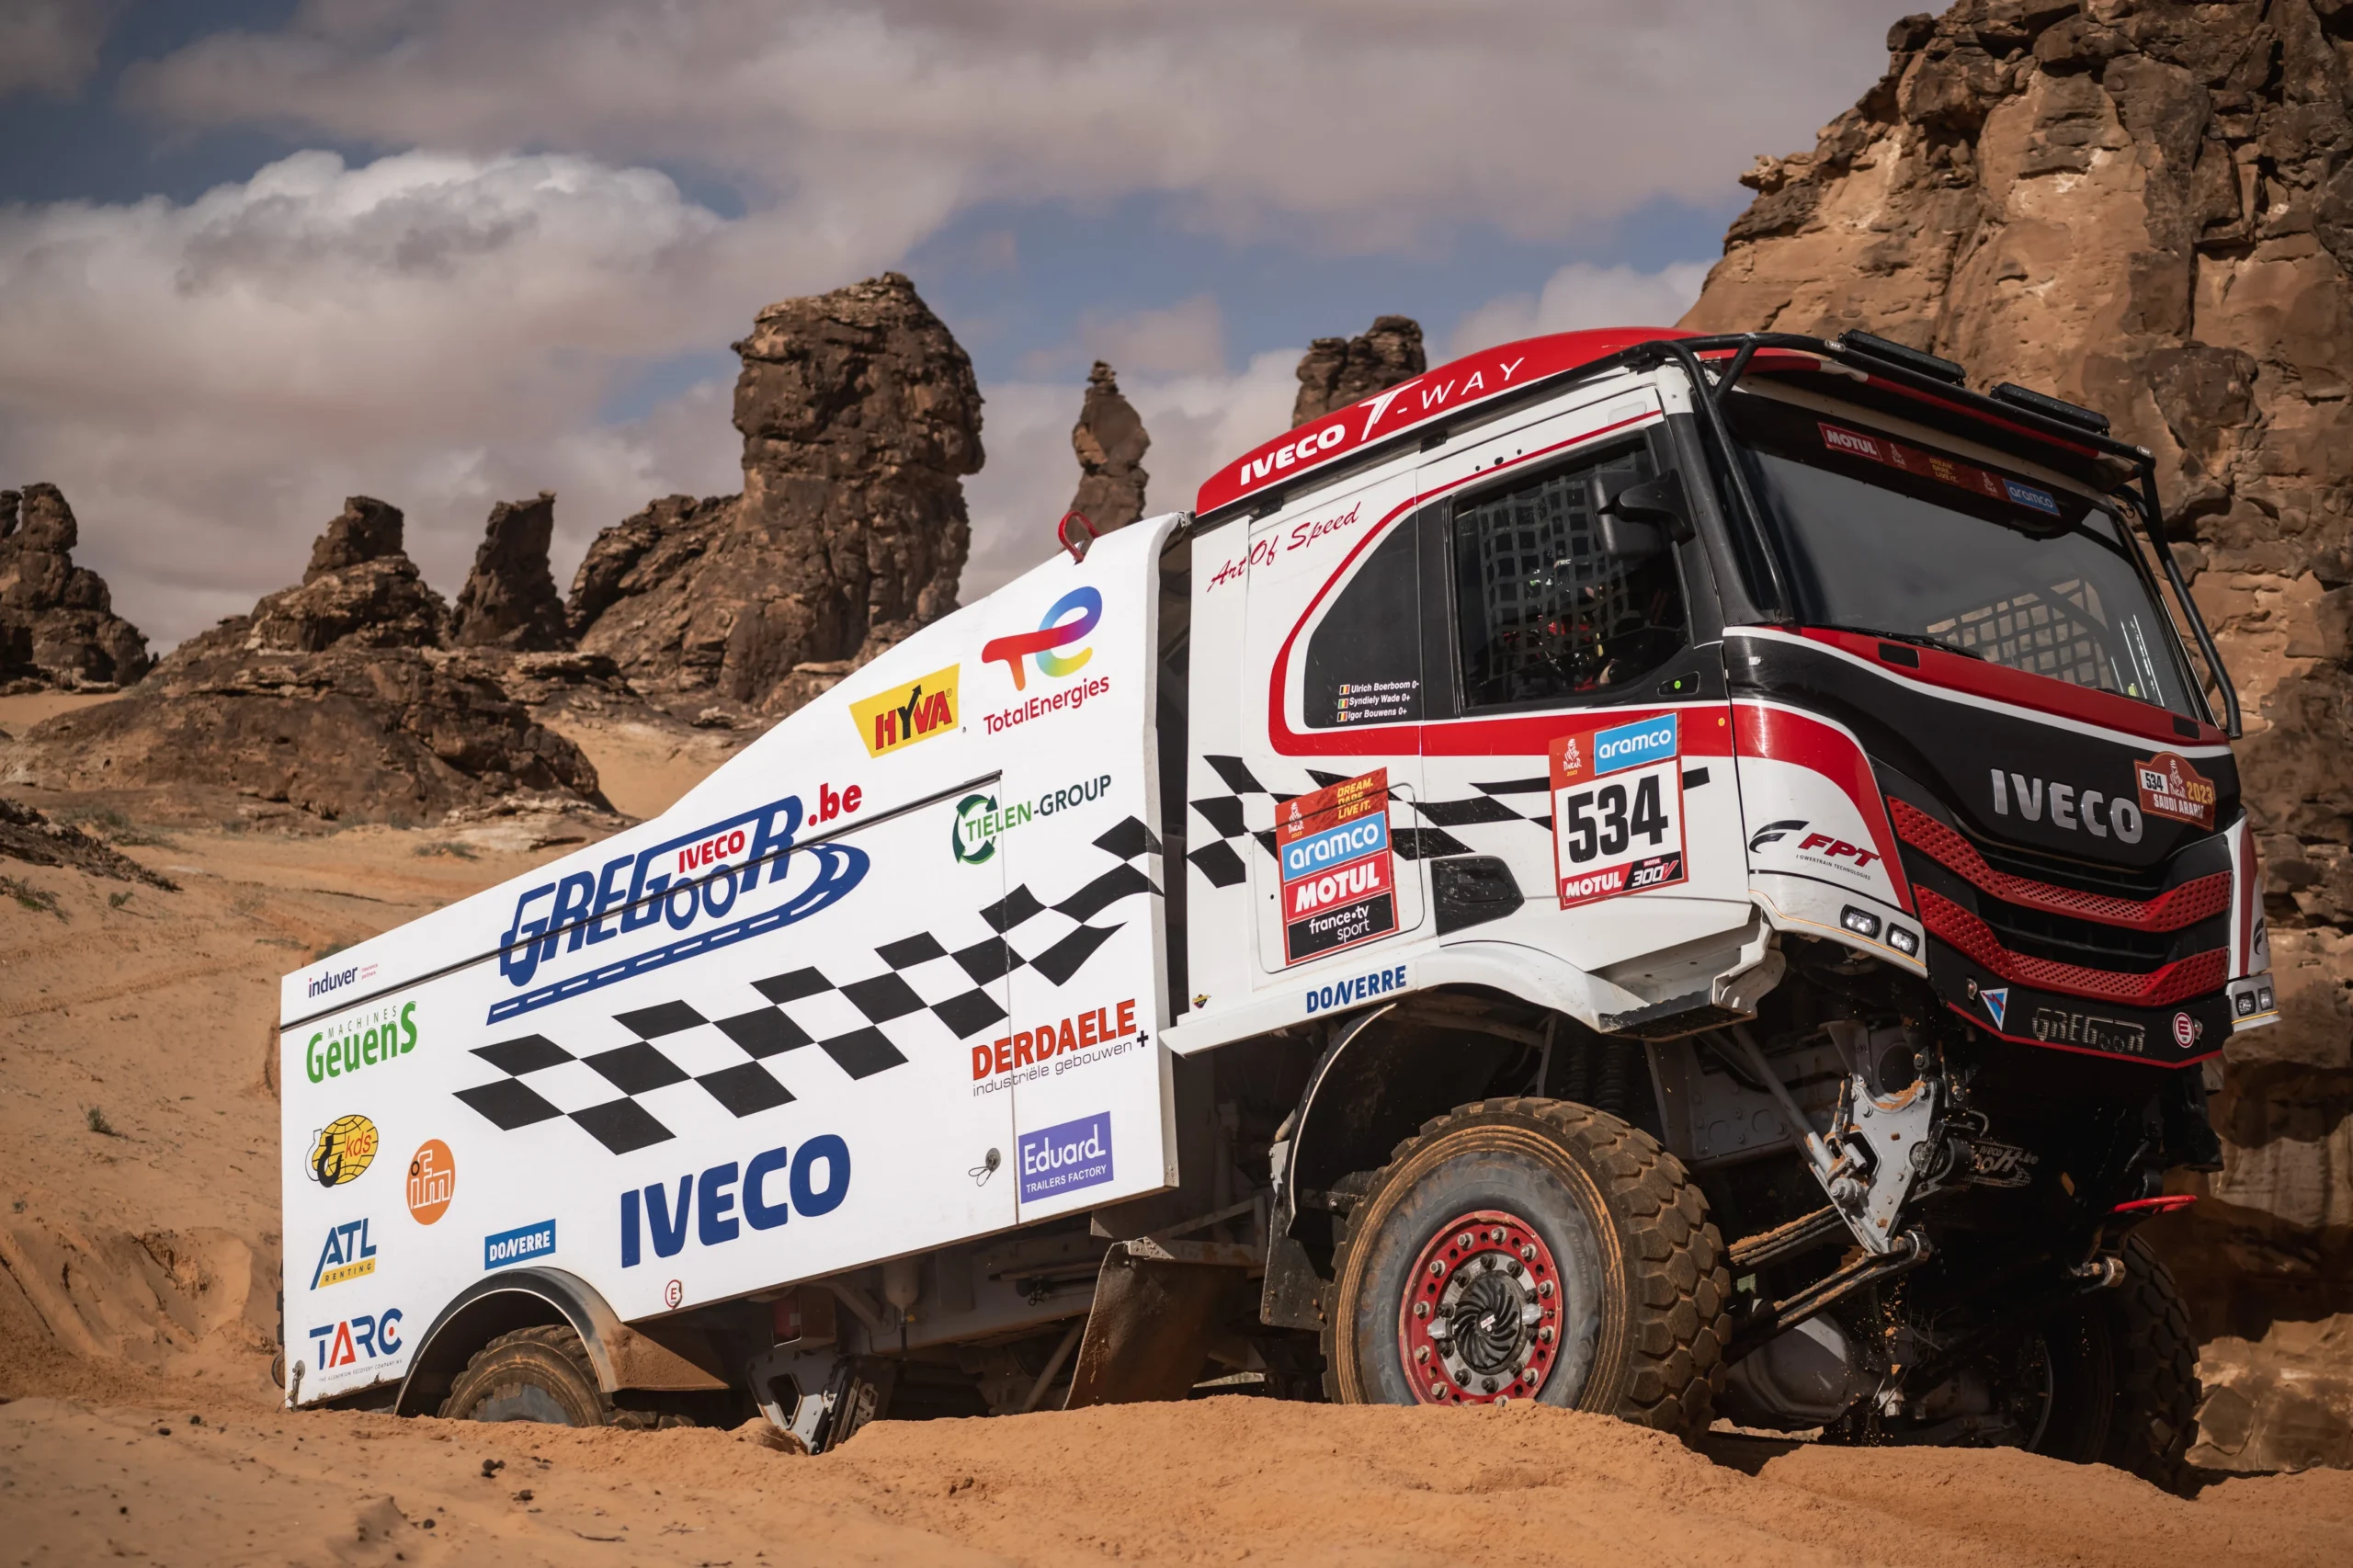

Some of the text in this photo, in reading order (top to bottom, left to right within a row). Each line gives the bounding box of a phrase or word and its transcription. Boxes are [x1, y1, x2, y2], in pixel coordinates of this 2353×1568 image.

[1240, 424, 1346, 486] IVECO
[1825, 429, 1878, 456] MOTUL
[2008, 486, 2053, 509] aramco
[1206, 501, 1361, 593] Art Of Speed
[1349, 696, 1380, 707] Syndiely
[1381, 694, 1400, 703] Wade
[1351, 684, 1372, 693] Ulrich
[1373, 681, 1410, 691] Boerboom
[875, 684, 953, 750] HYVA
[983, 676, 1109, 735] TotalEnergies
[1347, 711, 1362, 722] Igor
[1364, 709, 1396, 718] Bouwens
[1598, 729, 1672, 760] aramco
[1336, 777, 1374, 798] DREAM.
[2145, 772, 2164, 792] 534
[2187, 780, 2213, 805] 2023
[808, 782, 863, 826] .be
[965, 774, 1112, 842] TIELEN-GROUP
[1337, 800, 1371, 820] LIVE IT.
[1990, 768, 2143, 845] IVECO
[2153, 793, 2177, 812] SAUDI
[1567, 774, 1669, 864] 534
[678, 830, 745, 874] IVECO
[1290, 823, 1379, 870] aramco
[1643, 858, 1661, 867] MOTUL
[1797, 832, 1881, 868] FPT
[1295, 861, 1380, 913] MOTUL
[1565, 870, 1622, 897] MOTUL
[1631, 859, 1679, 887] 300V
[1834, 863, 1871, 881] TECHNOLOGIES
[1336, 918, 1370, 943] sport
[308, 964, 358, 998] induver
[1306, 965, 1406, 1014] DONERRE
[327, 1005, 398, 1040] MACHINES
[2178, 1020, 2189, 1036] E
[972, 998, 1137, 1081] DERDAELE
[972, 1064, 1050, 1097] industriële
[1055, 1040, 1132, 1075] gebouwen
[344, 1131, 372, 1159] kds
[1024, 1123, 1107, 1176] Eduard
[410, 1148, 451, 1210] ifm
[1026, 1165, 1107, 1194] TRAILERS FACTORY
[620, 1133, 851, 1268] IVECO
[310, 1217, 378, 1290] ATL
[489, 1230, 551, 1262] DONERRE
[324, 1262, 372, 1282] RENTING
[670, 1288, 677, 1301] E
[309, 1308, 404, 1370] TARC
[352, 1366, 373, 1375] RECOVERY
[374, 1361, 395, 1369] COMPANY
